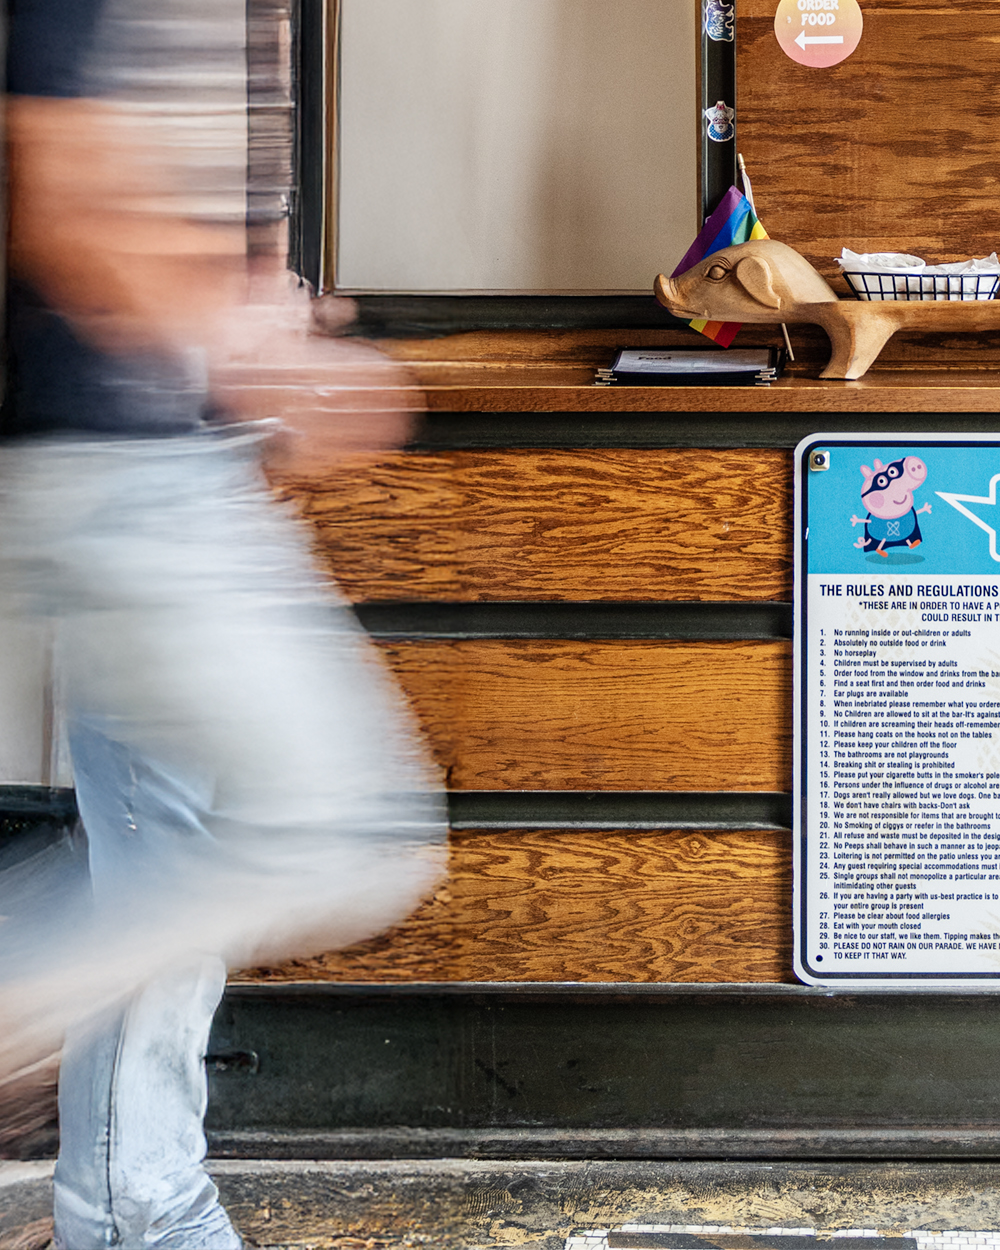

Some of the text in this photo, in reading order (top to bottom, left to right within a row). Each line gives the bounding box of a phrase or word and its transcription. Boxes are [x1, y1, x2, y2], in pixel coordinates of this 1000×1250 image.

[801, 12, 836, 26] FOOD
[819, 584, 842, 596] THE
[846, 584, 884, 596] RULES
[888, 585, 913, 596] AND
[917, 585, 999, 597] REGULATIONS
[921, 613, 949, 622] COULD
[951, 613, 982, 622] RESULT
[820, 639, 826, 647] 2.
[834, 639, 868, 647] Absolutely
[820, 649, 876, 658] 3. No horseplay
[858, 741, 873, 749] keep
[819, 922, 830, 930] 28.
